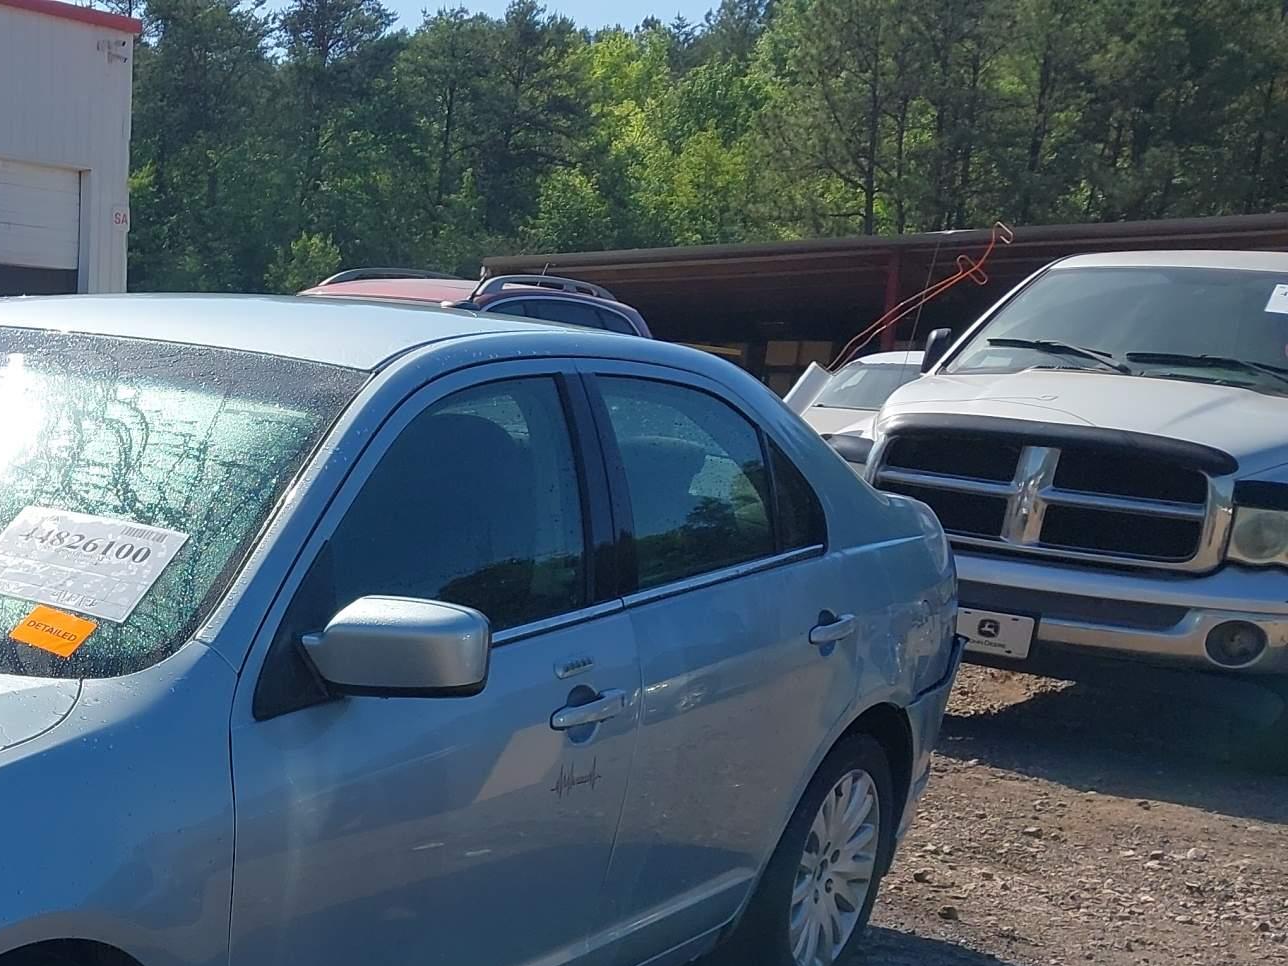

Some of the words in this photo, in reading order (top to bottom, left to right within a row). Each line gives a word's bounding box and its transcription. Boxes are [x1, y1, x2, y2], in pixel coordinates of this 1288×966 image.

[114, 212, 128, 225] SA
[19, 526, 152, 564] 44826100
[25, 619, 78, 643] DETAILED
